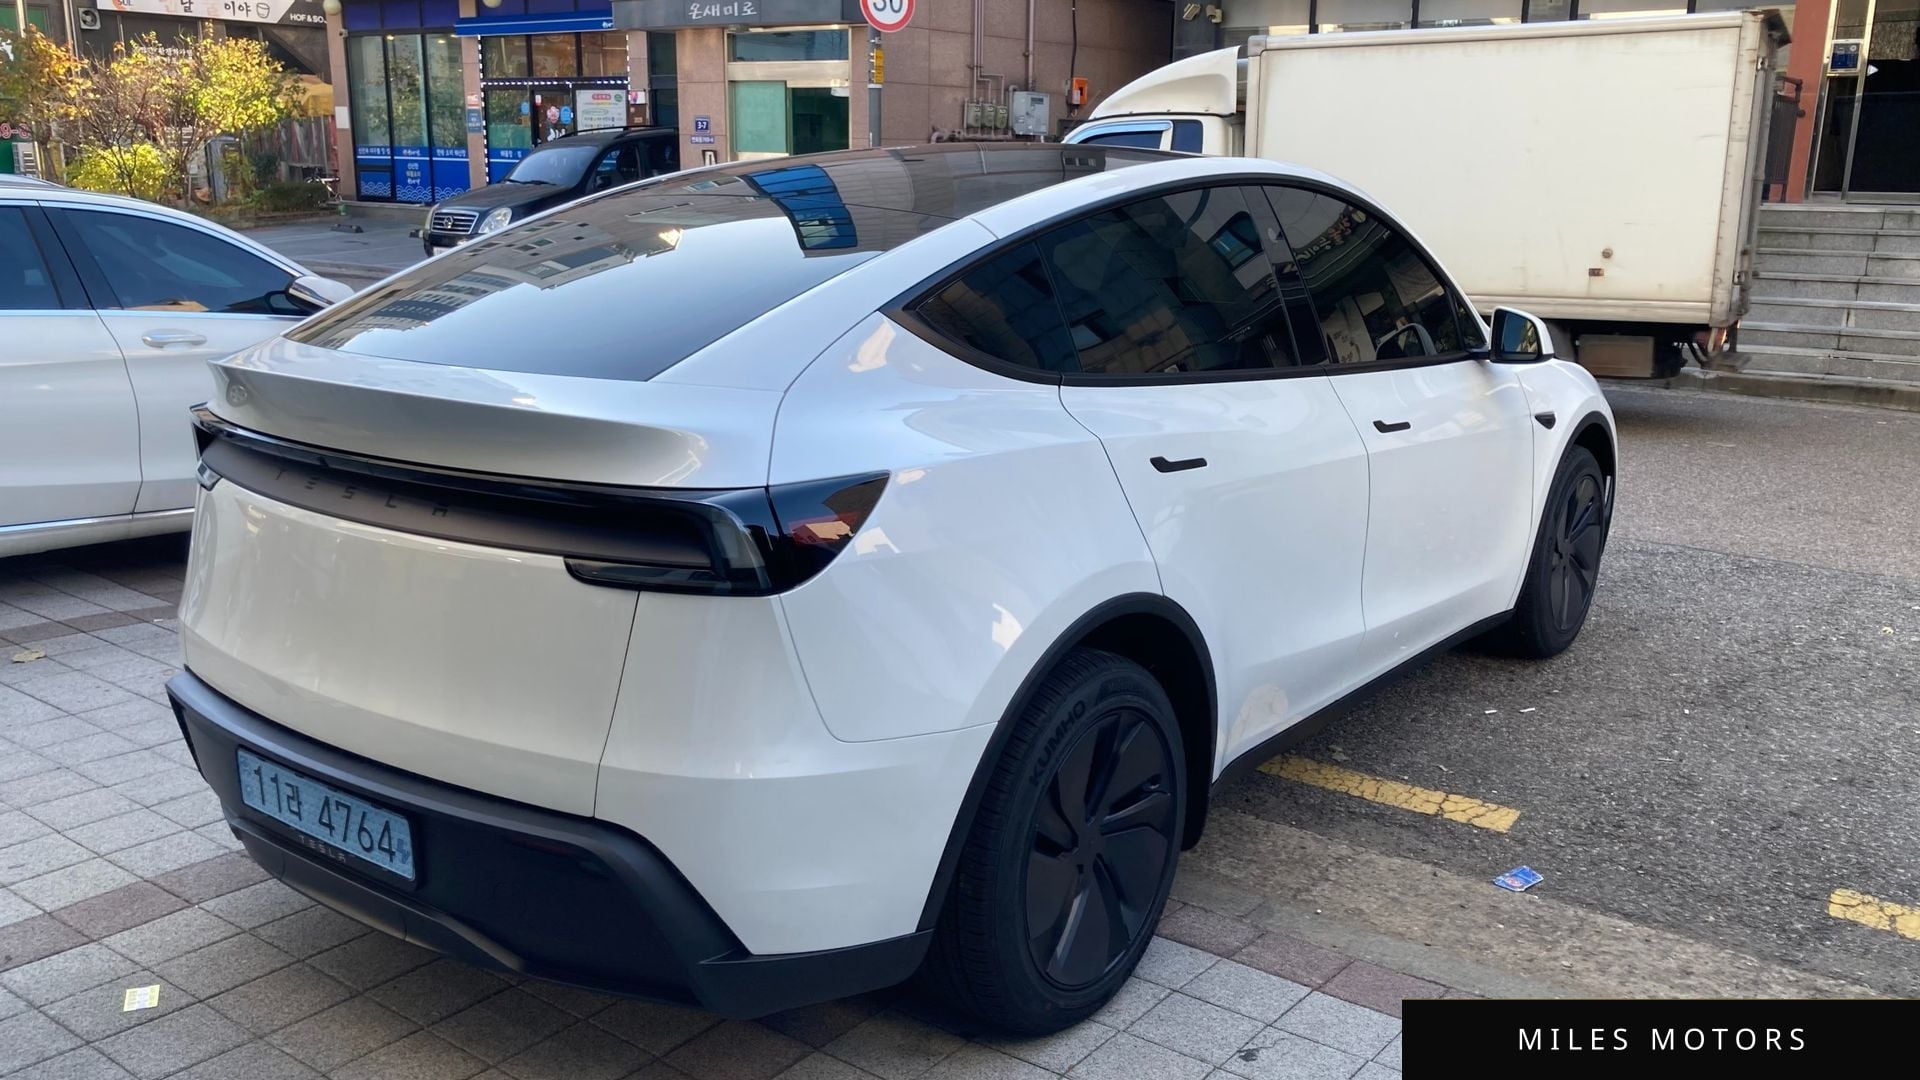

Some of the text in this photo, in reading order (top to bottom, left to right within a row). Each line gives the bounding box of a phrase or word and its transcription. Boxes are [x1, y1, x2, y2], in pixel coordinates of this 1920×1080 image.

[289, 13, 307, 22] HOF
[688, 2, 757, 19] 온새미로
[1029, 700, 1087, 787] KUMHO
[253, 765, 396, 863] 11라 4764
